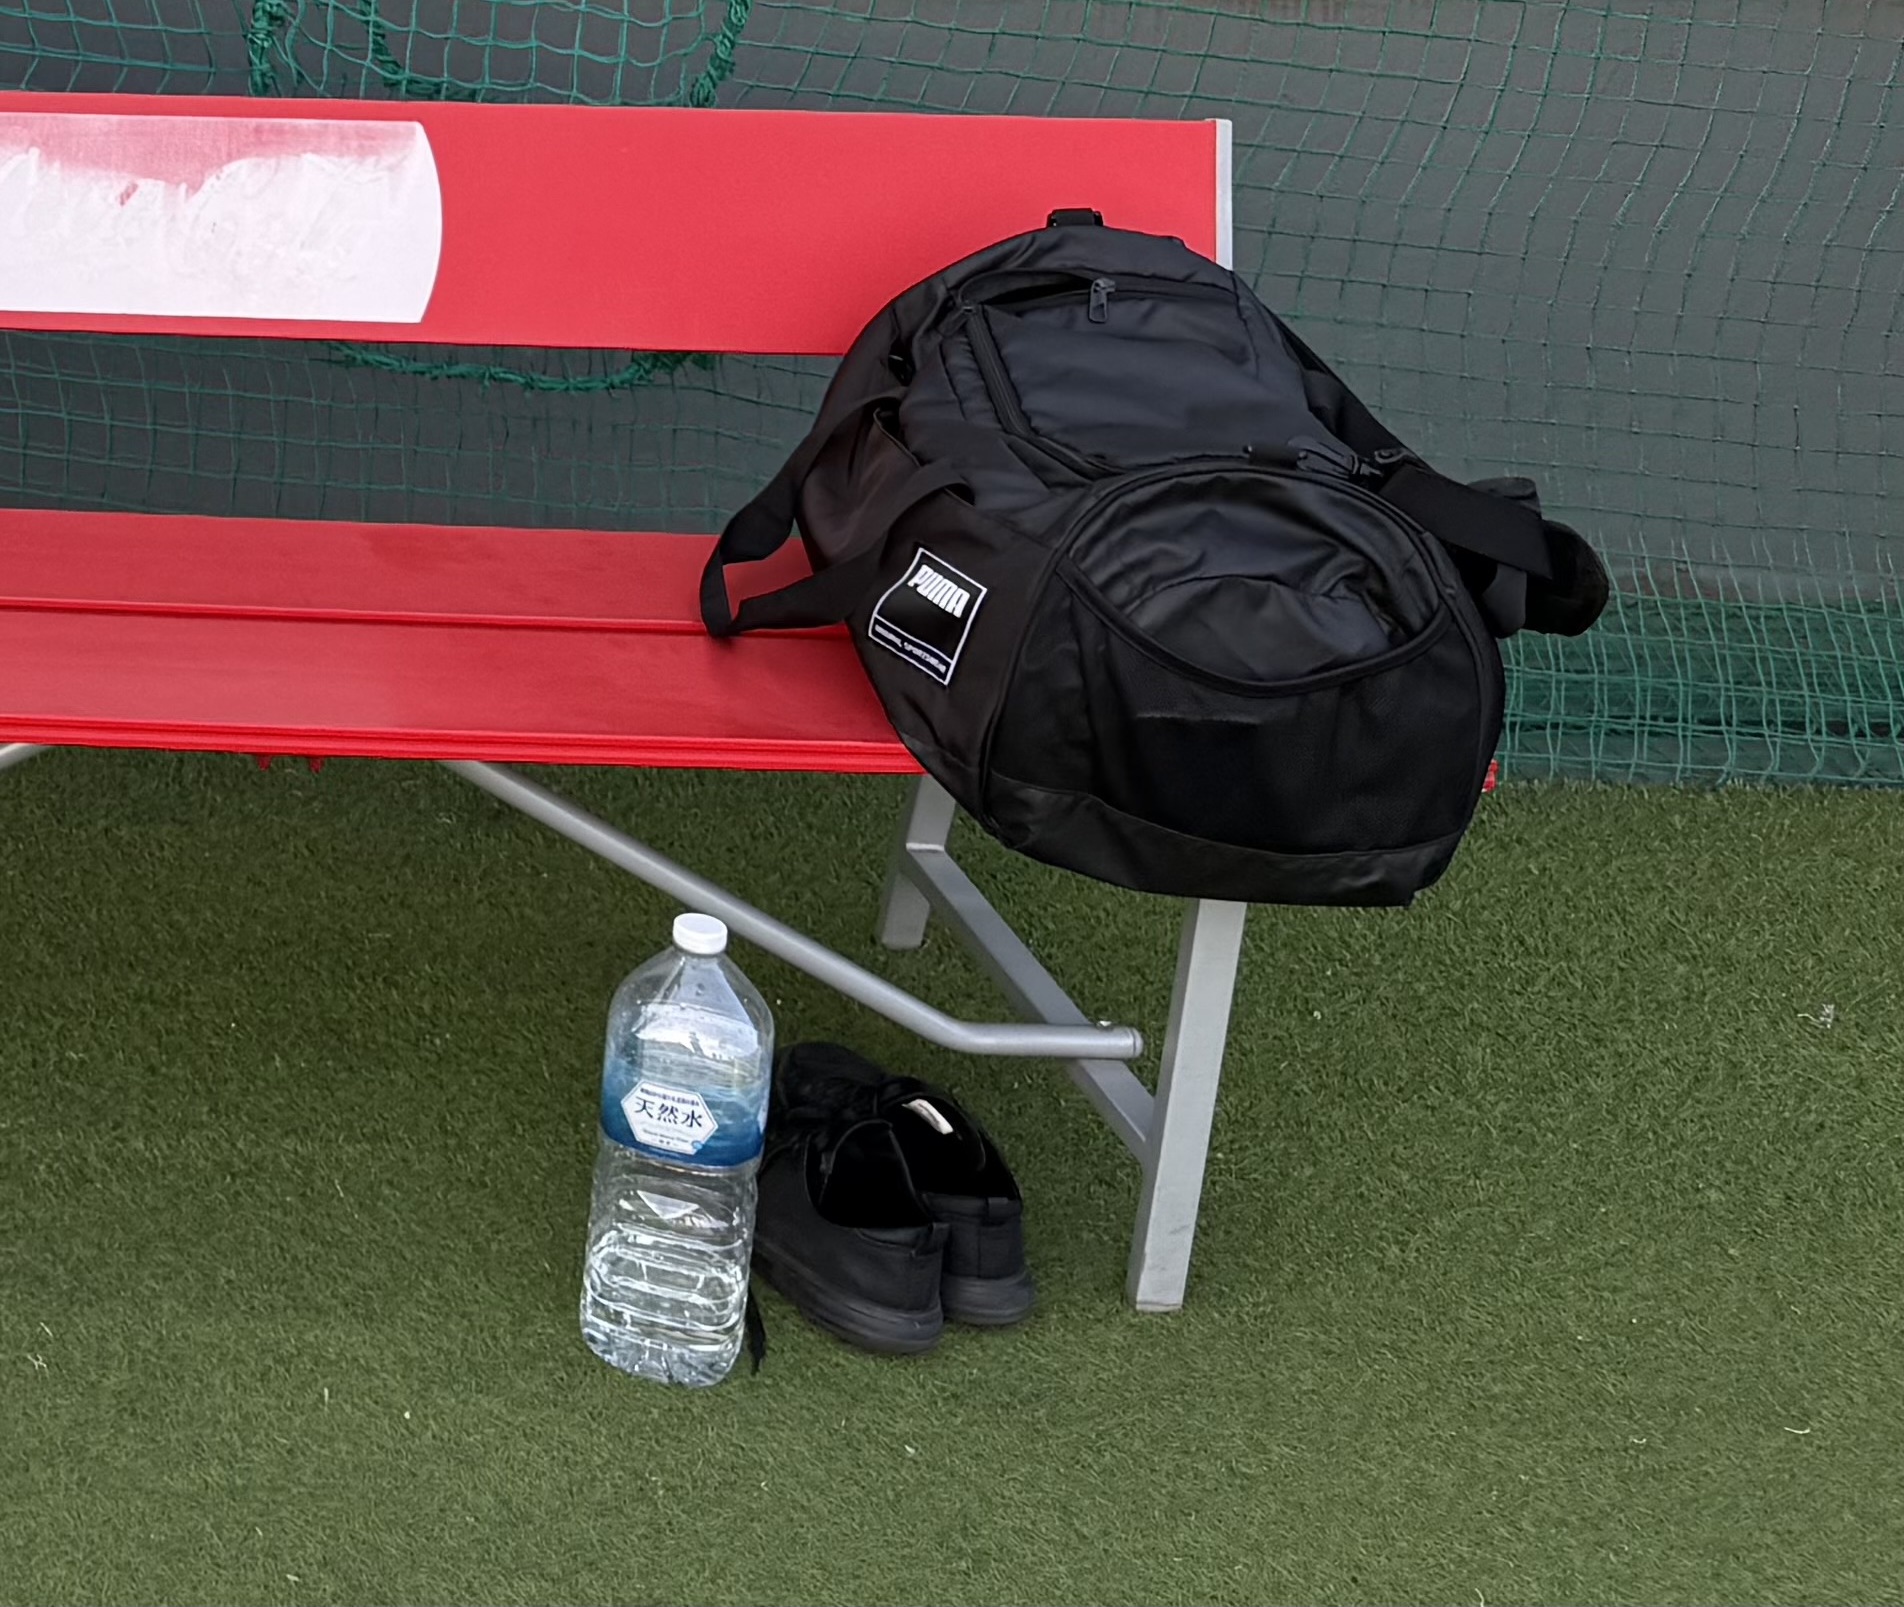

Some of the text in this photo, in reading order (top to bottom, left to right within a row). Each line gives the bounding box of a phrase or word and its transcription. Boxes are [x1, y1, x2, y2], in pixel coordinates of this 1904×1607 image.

[907, 563, 971, 619] PUMA
[634, 1096, 703, 1128] 天然水
